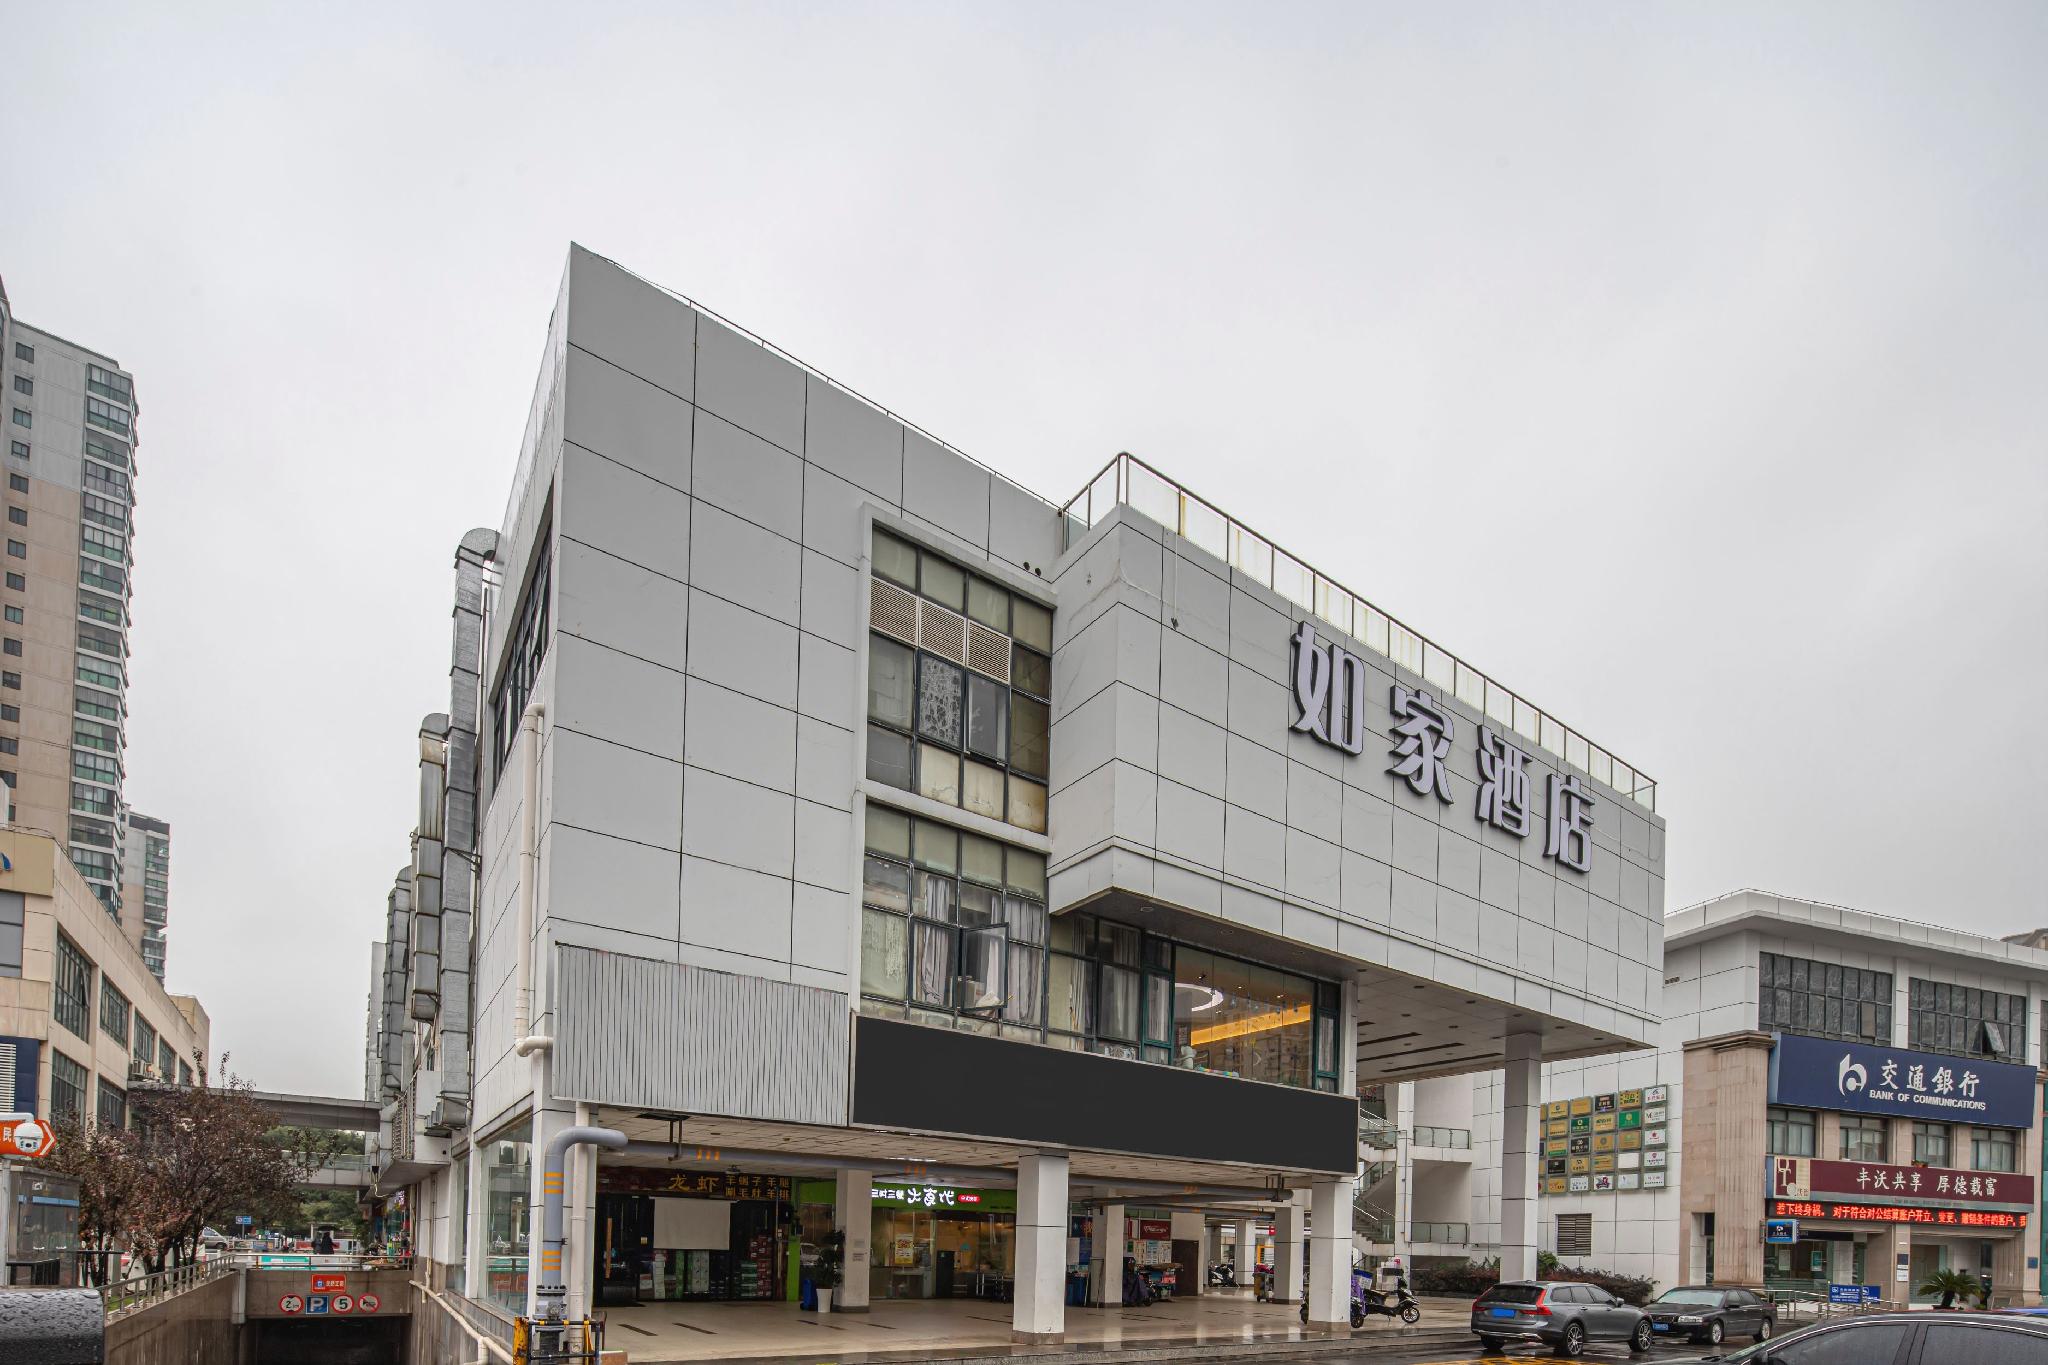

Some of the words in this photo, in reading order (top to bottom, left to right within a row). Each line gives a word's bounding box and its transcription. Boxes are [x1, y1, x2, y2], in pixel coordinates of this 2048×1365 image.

[1289, 620, 1595, 873] 如家酒店
[1869, 1089, 1894, 1100] BANK
[1897, 1093, 1910, 1102] OF
[1913, 1094, 1986, 1111] COMMUNICATIONS
[667, 1173, 720, 1193] 龙虾
[1856, 1167, 1923, 1193] 丰沃共享
[1936, 1175, 1997, 1197] 厚德载富
[310, 1297, 324, 1312] P
[339, 1298, 348, 1310] 5
